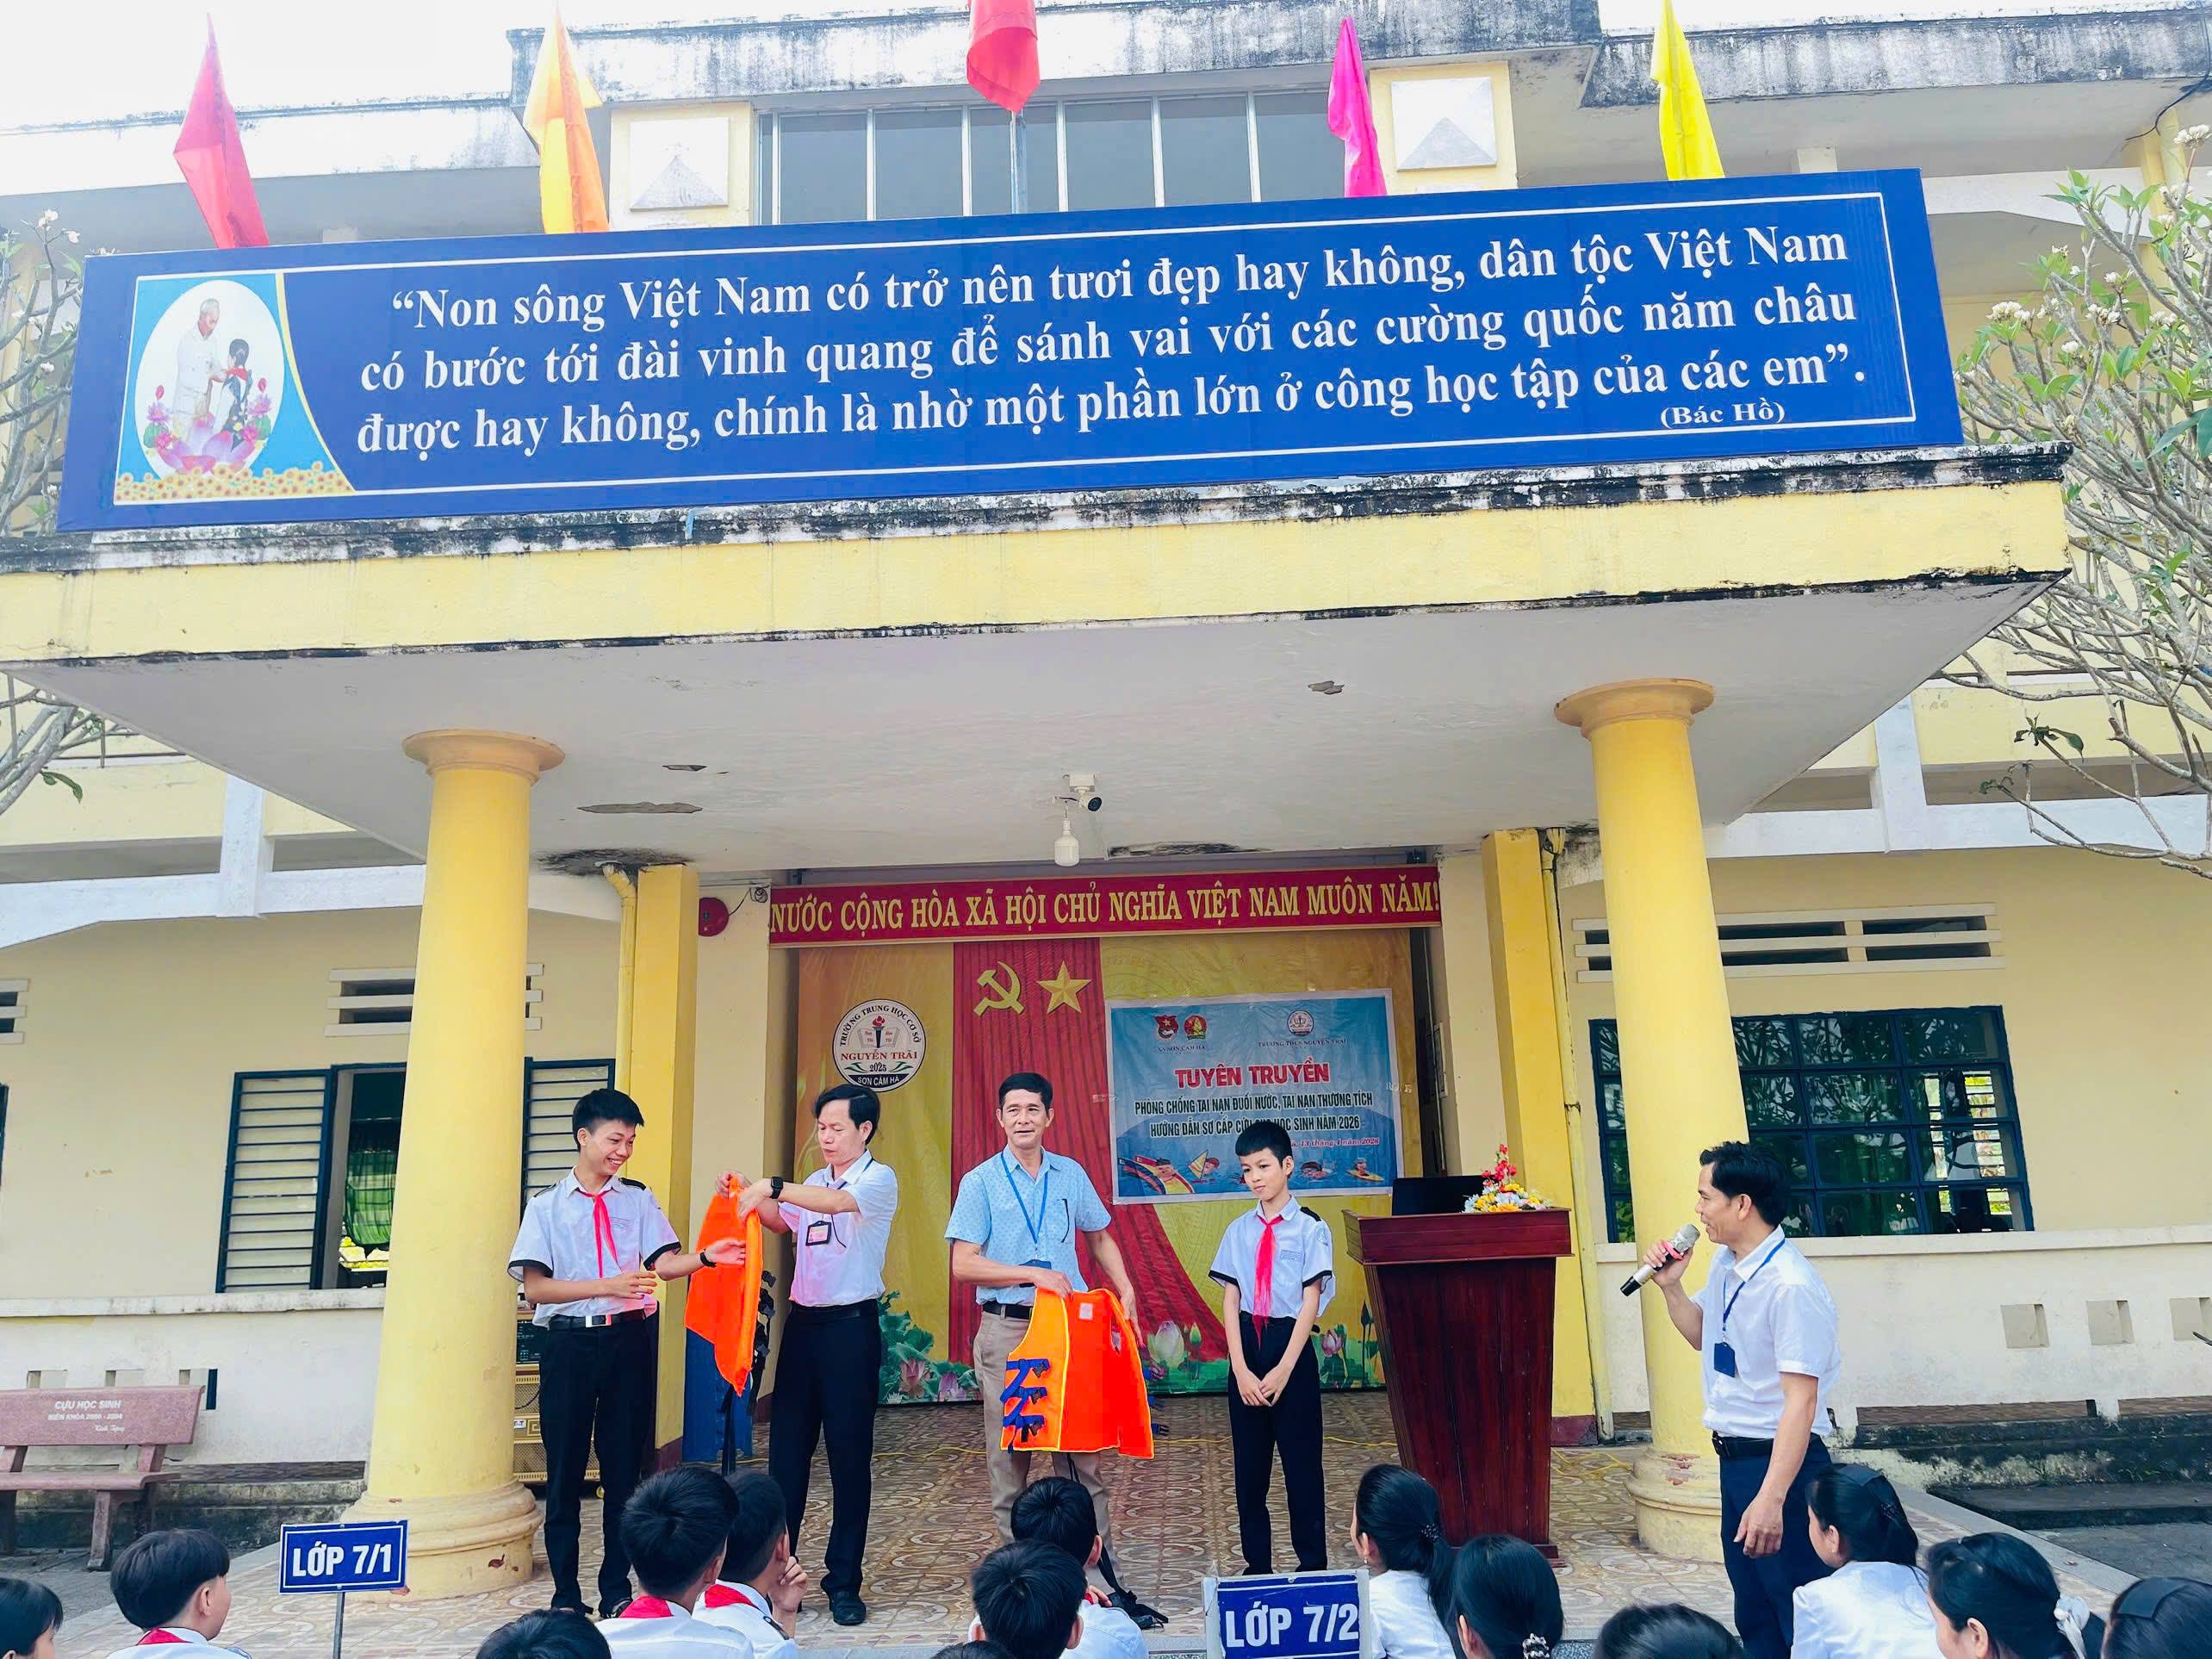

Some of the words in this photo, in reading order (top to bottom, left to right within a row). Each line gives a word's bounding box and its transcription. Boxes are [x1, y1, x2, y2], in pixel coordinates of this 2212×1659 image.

[513, 283, 606, 332] sông
[618, 277, 701, 329] Việt
[714, 276, 811, 315] Nam
[826, 271, 870, 311] có
[884, 268, 949, 308] trở
[961, 264, 1035, 305] nên
[1048, 258, 1134, 301] tươi
[1147, 258, 1221, 306] đẹp
[1235, 253, 1309, 301] hay
[1323, 245, 1465, 293] không,
[1480, 238, 1557, 279] dân
[1570, 233, 1634, 284] tộc
[1644, 228, 1733, 279] Việt
[1743, 226, 1849, 265] Nam
[361, 351, 405, 391] có
[424, 345, 525, 389] bước
[544, 342, 599, 383] tới
[617, 339, 680, 381] đài
[698, 336, 787, 376] vinh
[806, 340, 934, 383] quang
[951, 314, 998, 366] để
[1016, 320, 1111, 363] sánh
[1129, 316, 1191, 357] vai
[1208, 312, 1273, 353] với
[1291, 308, 1358, 350] các
[1376, 303, 1507, 351] cường
[1524, 283, 1624, 348] quốc
[1641, 291, 1737, 331] năm
[1754, 282, 1857, 326] châu
[357, 413, 461, 462] được
[474, 408, 549, 457] hay
[561, 401, 700, 451] không,
[714, 395, 828, 438] chính
[842, 392, 879, 432] là
[892, 388, 973, 430] nhờ
[985, 382, 1065, 435] một
[1077, 367, 1182, 433] phần
[1194, 374, 1262, 415] lớn
[1276, 371, 1303, 412] ở
[1314, 367, 1414, 417] công
[1424, 364, 1499, 413] học
[1510, 357, 1579, 409] tập
[1594, 354, 1668, 395] của
[1681, 349, 1750, 391] các
[1660, 407, 1724, 429] (Bác
[1733, 397, 1786, 424] Hồ)
[771, 893, 832, 933] NƯỚC
[841, 892, 904, 936] CỘNG
[911, 889, 959, 928] HÒA
[966, 888, 997, 926] XÃ
[1005, 886, 1046, 931] HỘI
[1054, 882, 1100, 923] CHỦ
[1109, 884, 1183, 922] NGHĨA
[1187, 880, 1241, 925] VIỆT
[1249, 886, 1300, 917] NAM
[1308, 876, 1373, 916] MUÔN
[1380, 874, 1439, 913] NĂM!
[840, 1013, 861, 1047] TRƯỜNG
[861, 1005, 890, 1016] TRUNG
[891, 1006, 909, 1020] HỌC
[906, 1019, 916, 1031] CƠ
[841, 1049, 887, 1060] NGUYỄN
[891, 1050, 917, 1059] TRÃI
[869, 1061, 887, 1072] 2025
[1175, 1063, 1242, 1088] TUYÊN
[1248, 1057, 1330, 1085] TRUYỀN
[1134, 1098, 1164, 1115] PHÒNG
[1166, 1096, 1195, 1114] CHỐNG
[1197, 1098, 1209, 1113] TAI
[1212, 1097, 1230, 1115] NẠN
[1232, 1092, 1252, 1110] ĐUỐI
[1255, 1093, 1281, 1110] NƯỚC,
[1283, 1095, 1295, 1109] TAI
[1297, 1094, 1315, 1111] NẠN
[1317, 1093, 1351, 1108] THƯƠNG
[1353, 1090, 1373, 1106] TÍCH
[1150, 1120, 1179, 1137] HƯỚNG
[1182, 1117, 1200, 1136] DẪN
[1202, 1121, 1214, 1134] SƠ
[1216, 1116, 1233, 1134] CẤP
[1294, 1117, 1314, 1131] SINH
[1316, 1114, 1336, 1130] NĂM
[1339, 1115, 1359, 1129] 2026
[54, 1401, 75, 1411] CỰU
[76, 1400, 97, 1411] HỌC
[99, 1400, 121, 1408] SINH
[292, 1540, 345, 1577] LỚP
[352, 1544, 392, 1575] 7/1
[1225, 1600, 1292, 1648] LỚP
[1302, 1603, 1359, 1643] 7/2
